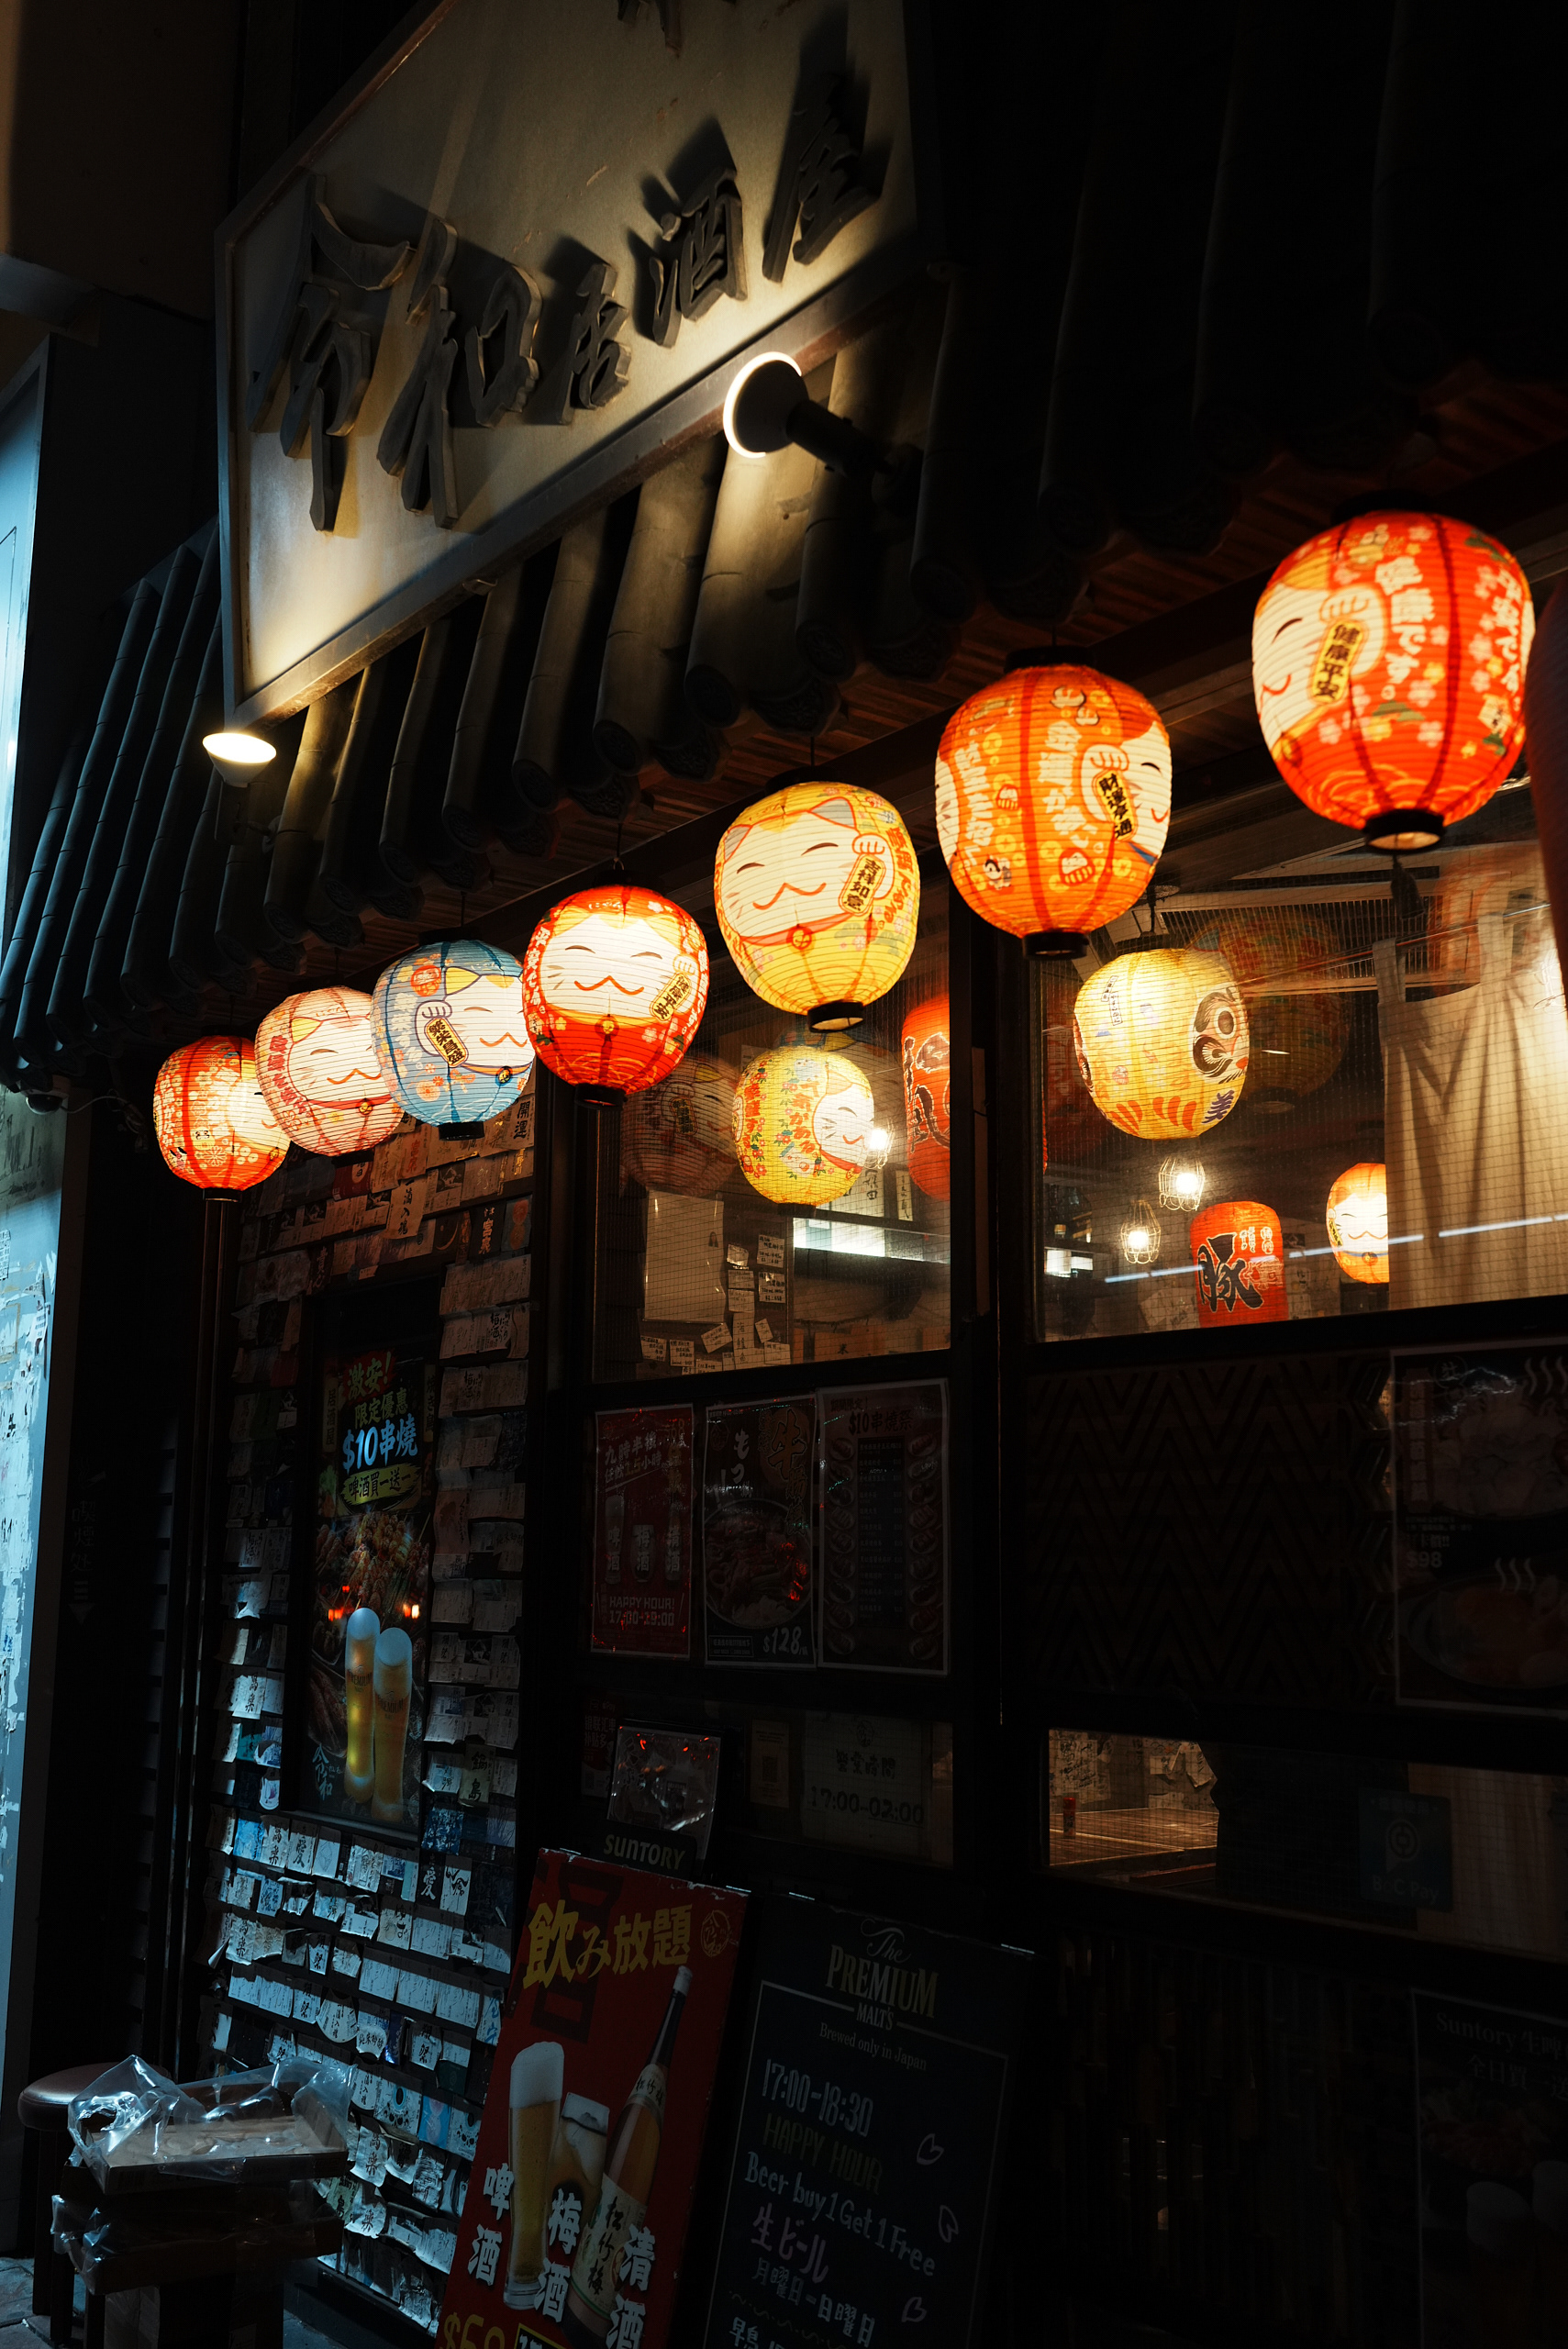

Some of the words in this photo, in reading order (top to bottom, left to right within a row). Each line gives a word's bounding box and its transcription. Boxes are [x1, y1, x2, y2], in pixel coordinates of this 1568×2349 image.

[347, 1351, 393, 1400] 激安!
[354, 1387, 409, 1429] 限定優惠
[342, 1413, 418, 1475] $10串燒
[349, 1467, 412, 1502] 啤酒買一送一
[609, 1596, 642, 1609] HAPPY
[643, 1597, 675, 1611] HOUR!
[836, 1748, 896, 1780] 營業時間
[811, 1785, 925, 1824] 17:00-02:00
[604, 1834, 686, 1871] SUNTORY
[523, 1899, 693, 1989] 飲み放題
[861, 1918, 912, 1964] The
[826, 1944, 939, 2019] PREMIUM
[856, 2001, 895, 2032] MALT'S
[1436, 2011, 1517, 2054] Suntory
[1519, 2030, 1568, 2063] 生啤
[819, 2021, 856, 2049] Brewed
[858, 2037, 881, 2060] only
[882, 2043, 894, 2059] in
[895, 2046, 928, 2071] Japan
[762, 2058, 873, 2138] 17:00-18:30
[744, 2151, 789, 2195] Beer
[762, 2112, 825, 2167] HAPPY
[829, 2141, 883, 2196] HOUR
[467, 2163, 515, 2287] 啤酒
[587, 2196, 625, 2296] 松竹梅
[751, 2202, 828, 2284] 生ビール
[534, 2188, 583, 2323] 梅酒
[606, 2223, 656, 2349] 清酒
